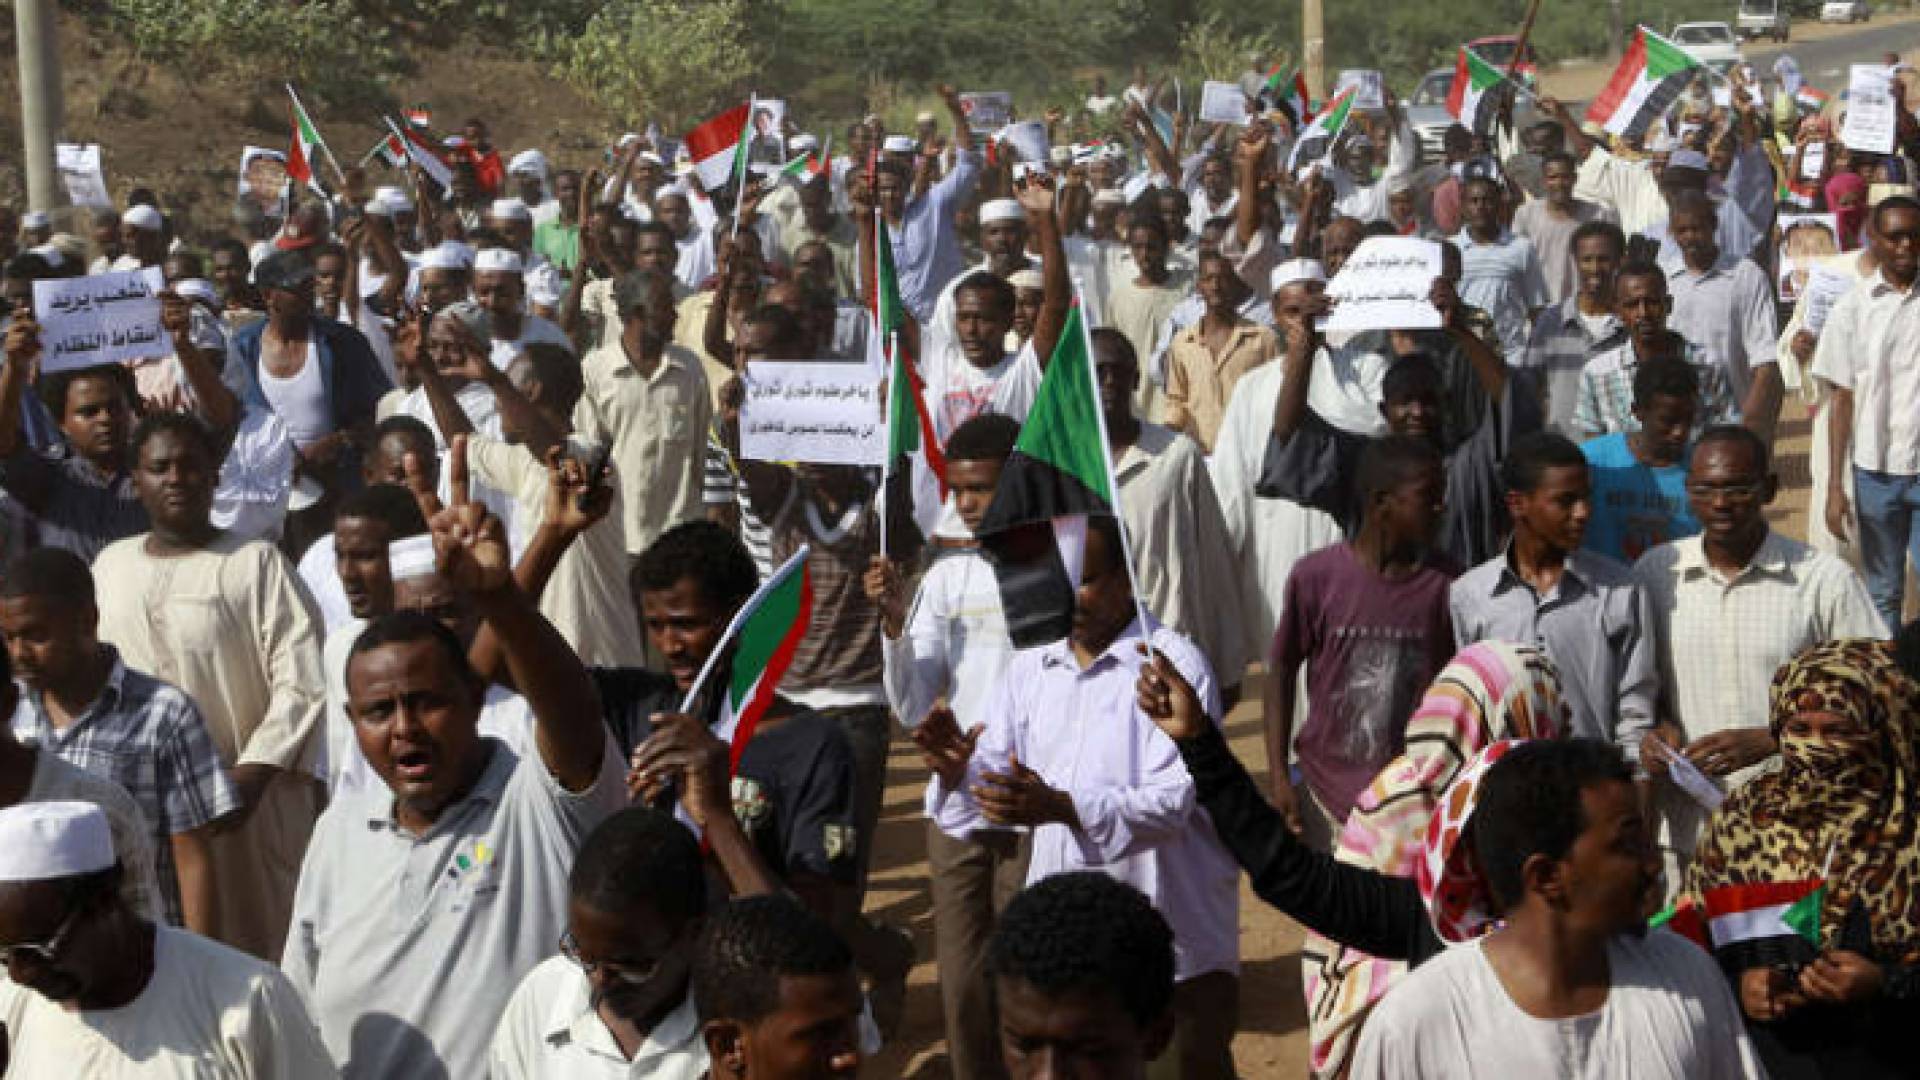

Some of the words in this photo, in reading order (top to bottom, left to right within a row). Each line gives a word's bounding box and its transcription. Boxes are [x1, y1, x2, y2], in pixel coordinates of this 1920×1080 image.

[50, 294, 92, 313] يريد
[93, 279, 152, 308] الشعب
[53, 331, 109, 359] النظام
